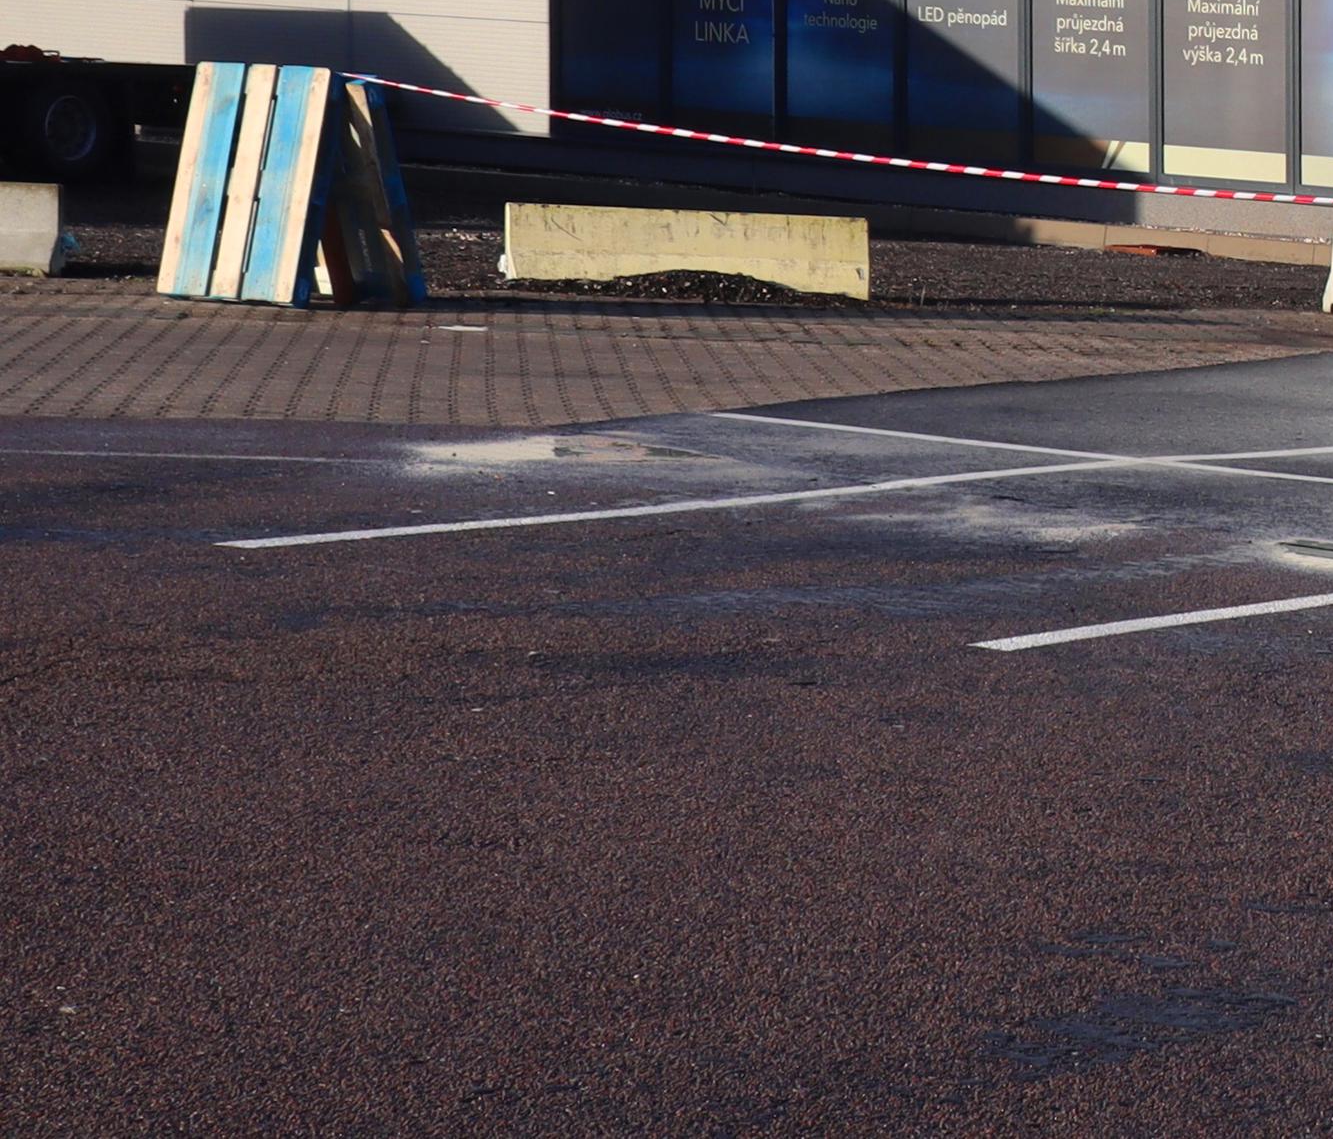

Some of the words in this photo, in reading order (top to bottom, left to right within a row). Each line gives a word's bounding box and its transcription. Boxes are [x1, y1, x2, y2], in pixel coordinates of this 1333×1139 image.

[804, 12, 878, 33] technologie
[917, 6, 944, 23] LED
[947, 8, 1008, 28] pěnopád
[1056, 13, 1124, 35] průjezdná
[694, 20, 750, 44] LINKA
[1188, 21, 1259, 43] průjezdná
[1054, 36, 1086, 55] šířka
[1089, 39, 1111, 58] 2,4
[1182, 47, 1222, 66] výška
[1225, 47, 1248, 67] 2,4
[1250, 51, 1264, 65] m
